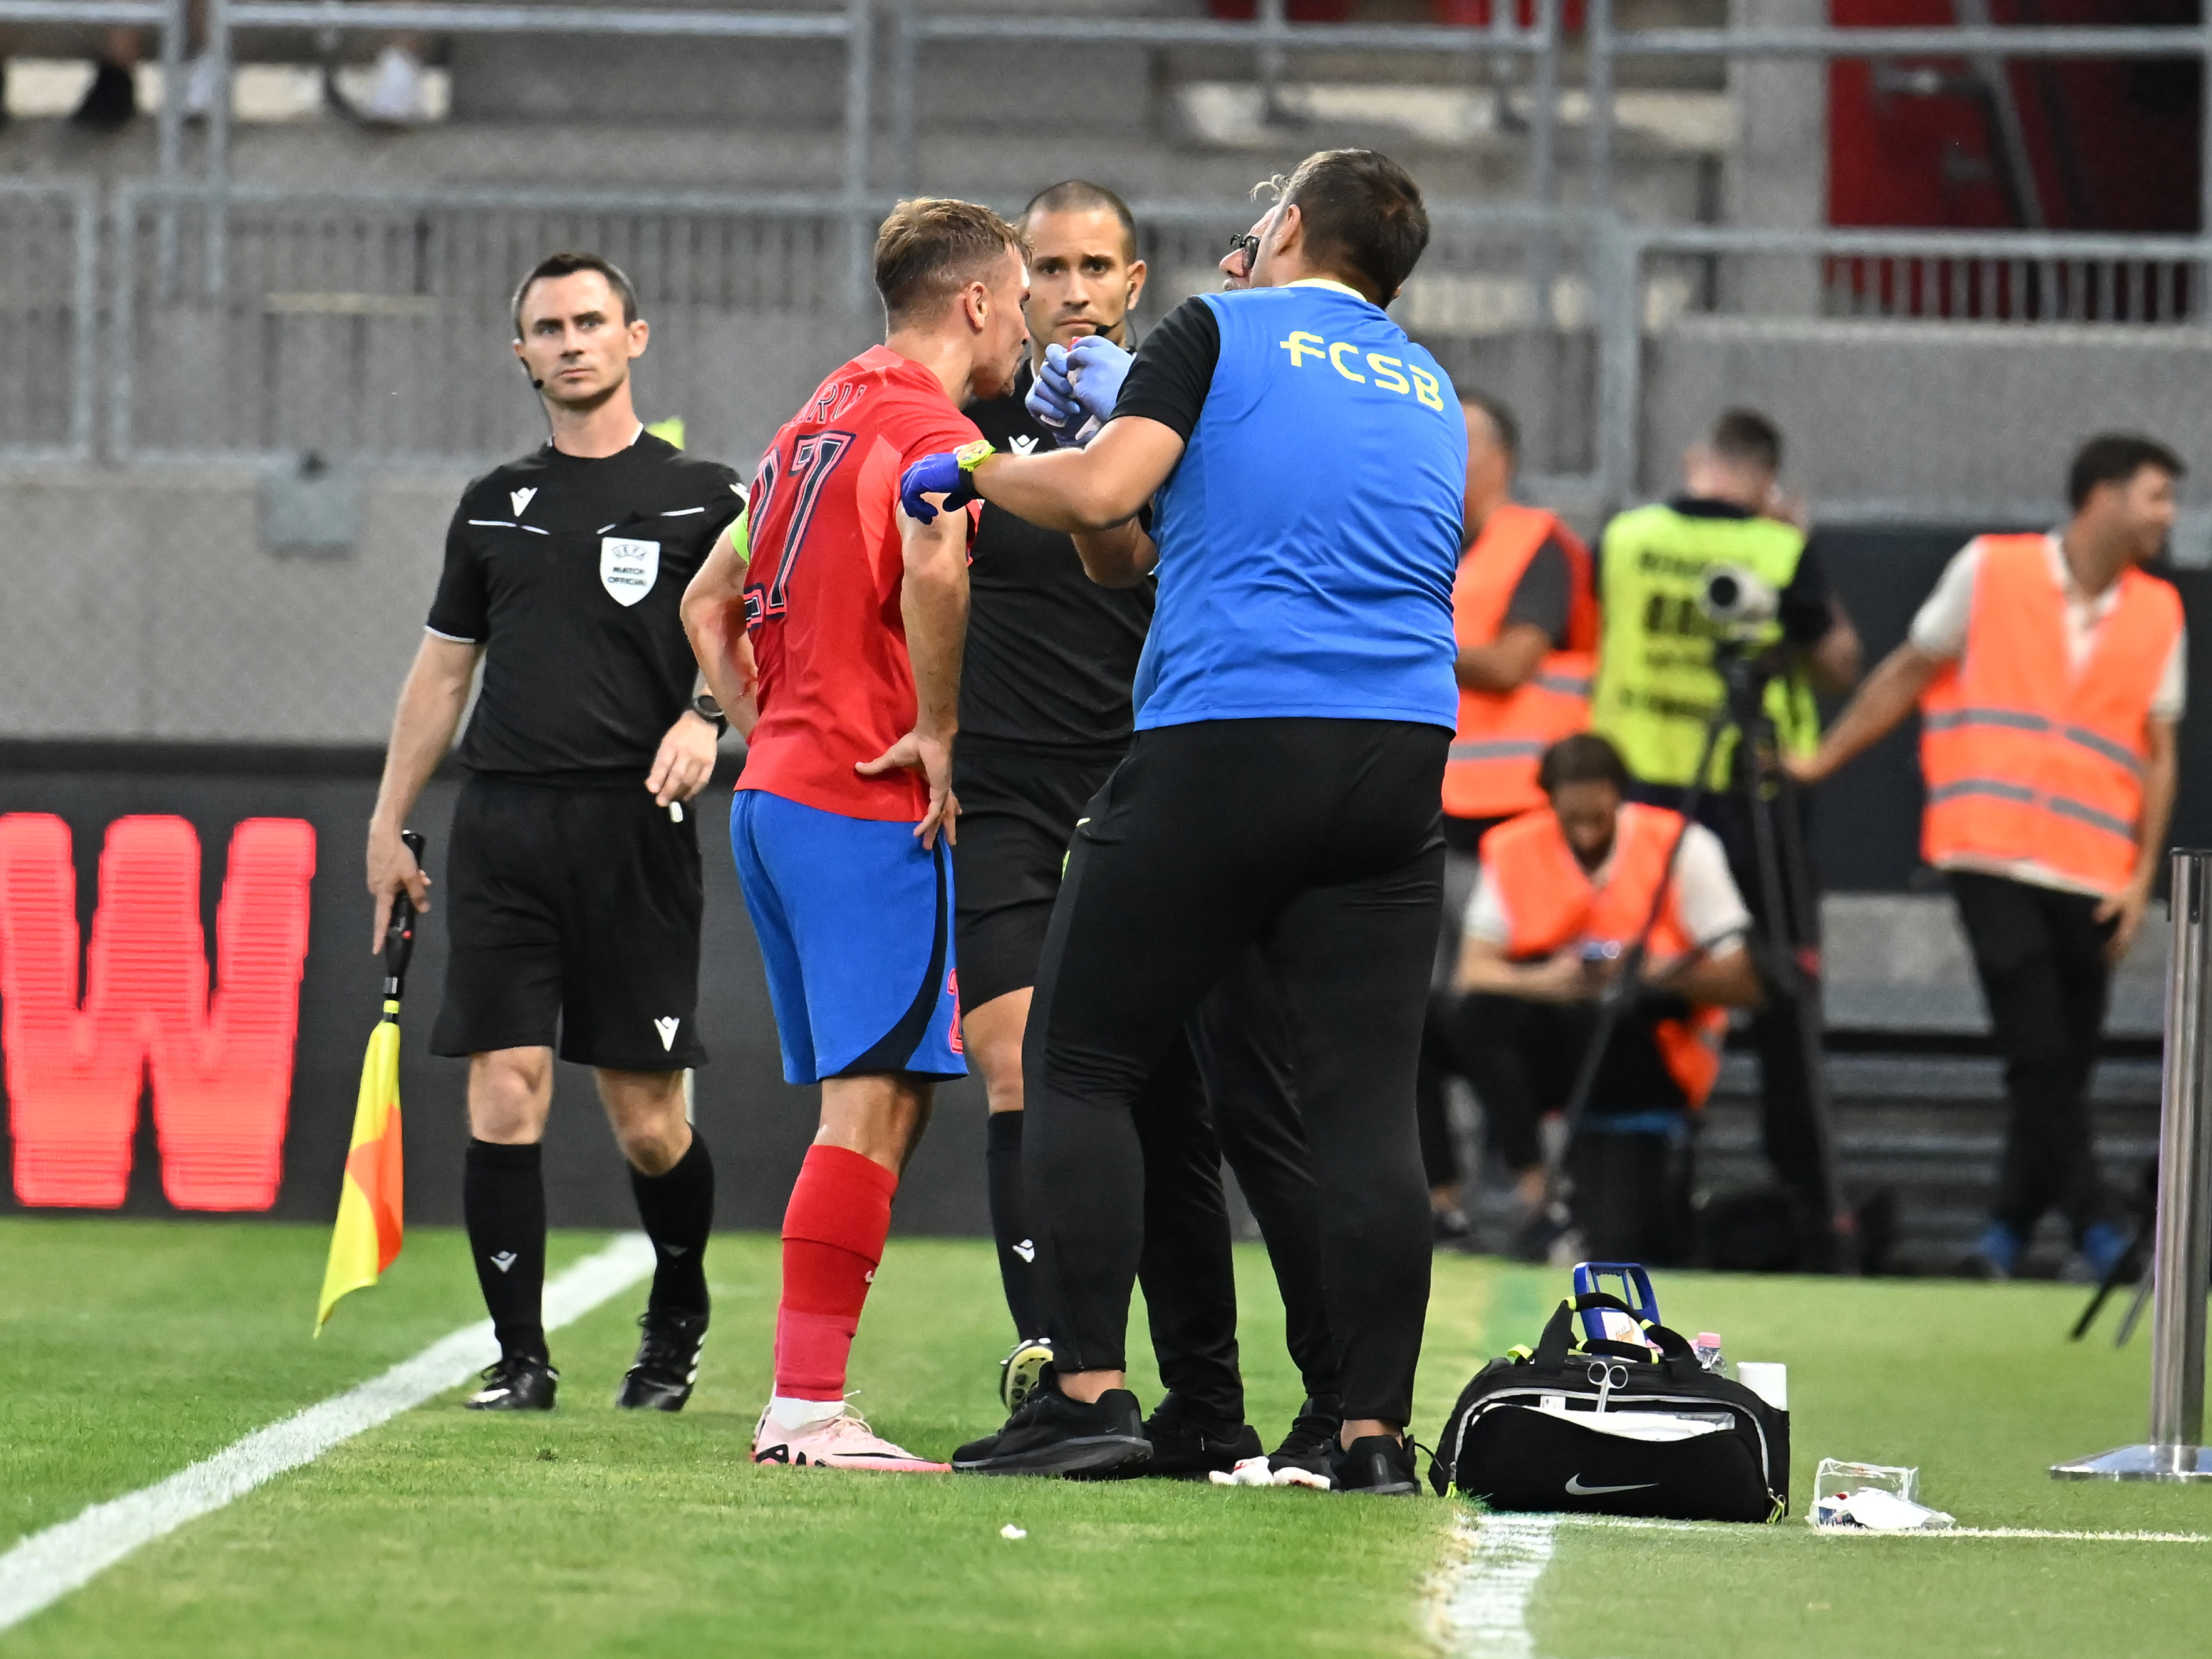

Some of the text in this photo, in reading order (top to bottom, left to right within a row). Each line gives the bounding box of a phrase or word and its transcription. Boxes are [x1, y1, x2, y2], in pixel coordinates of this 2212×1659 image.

[1280, 331, 1445, 412] FCSB
[743, 430, 857, 629] 27
[612, 544, 648, 561] UEFA
[612, 566, 646, 576] MATCH
[608, 576, 648, 587] OFFICIAL
